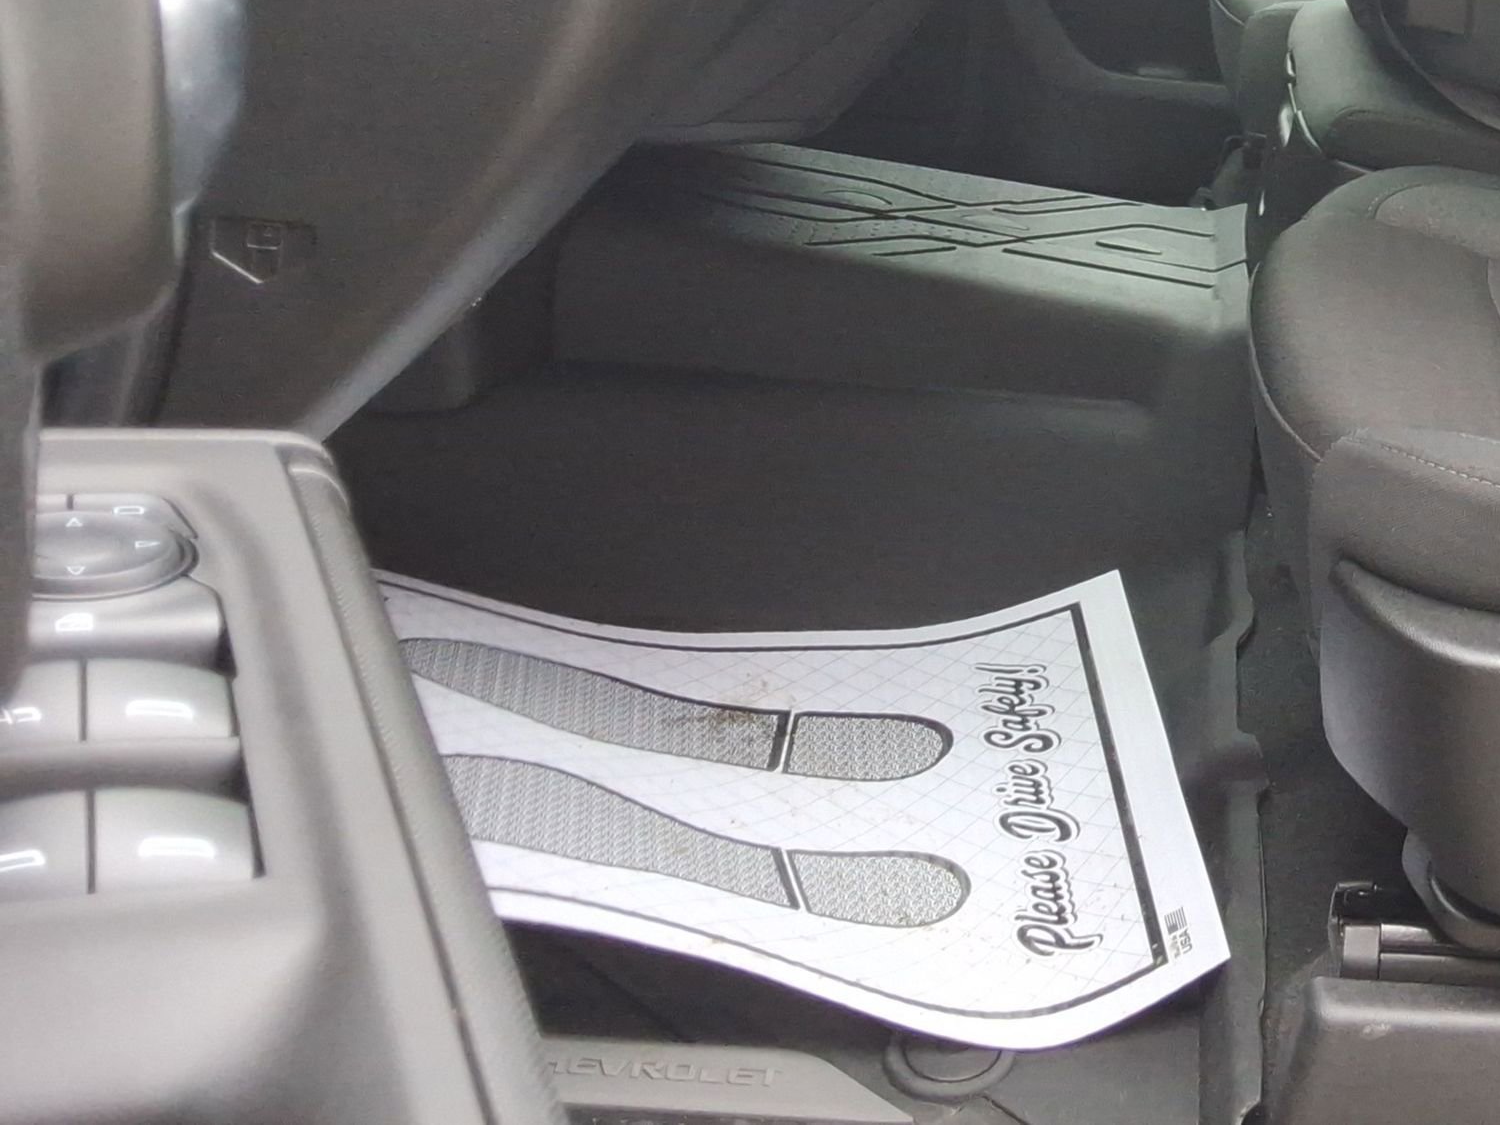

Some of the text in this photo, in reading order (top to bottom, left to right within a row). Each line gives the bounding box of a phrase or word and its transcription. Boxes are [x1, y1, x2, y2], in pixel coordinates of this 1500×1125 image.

[976, 662, 1102, 955] Please Drive Safely!
[1179, 927, 1193, 955] USA
